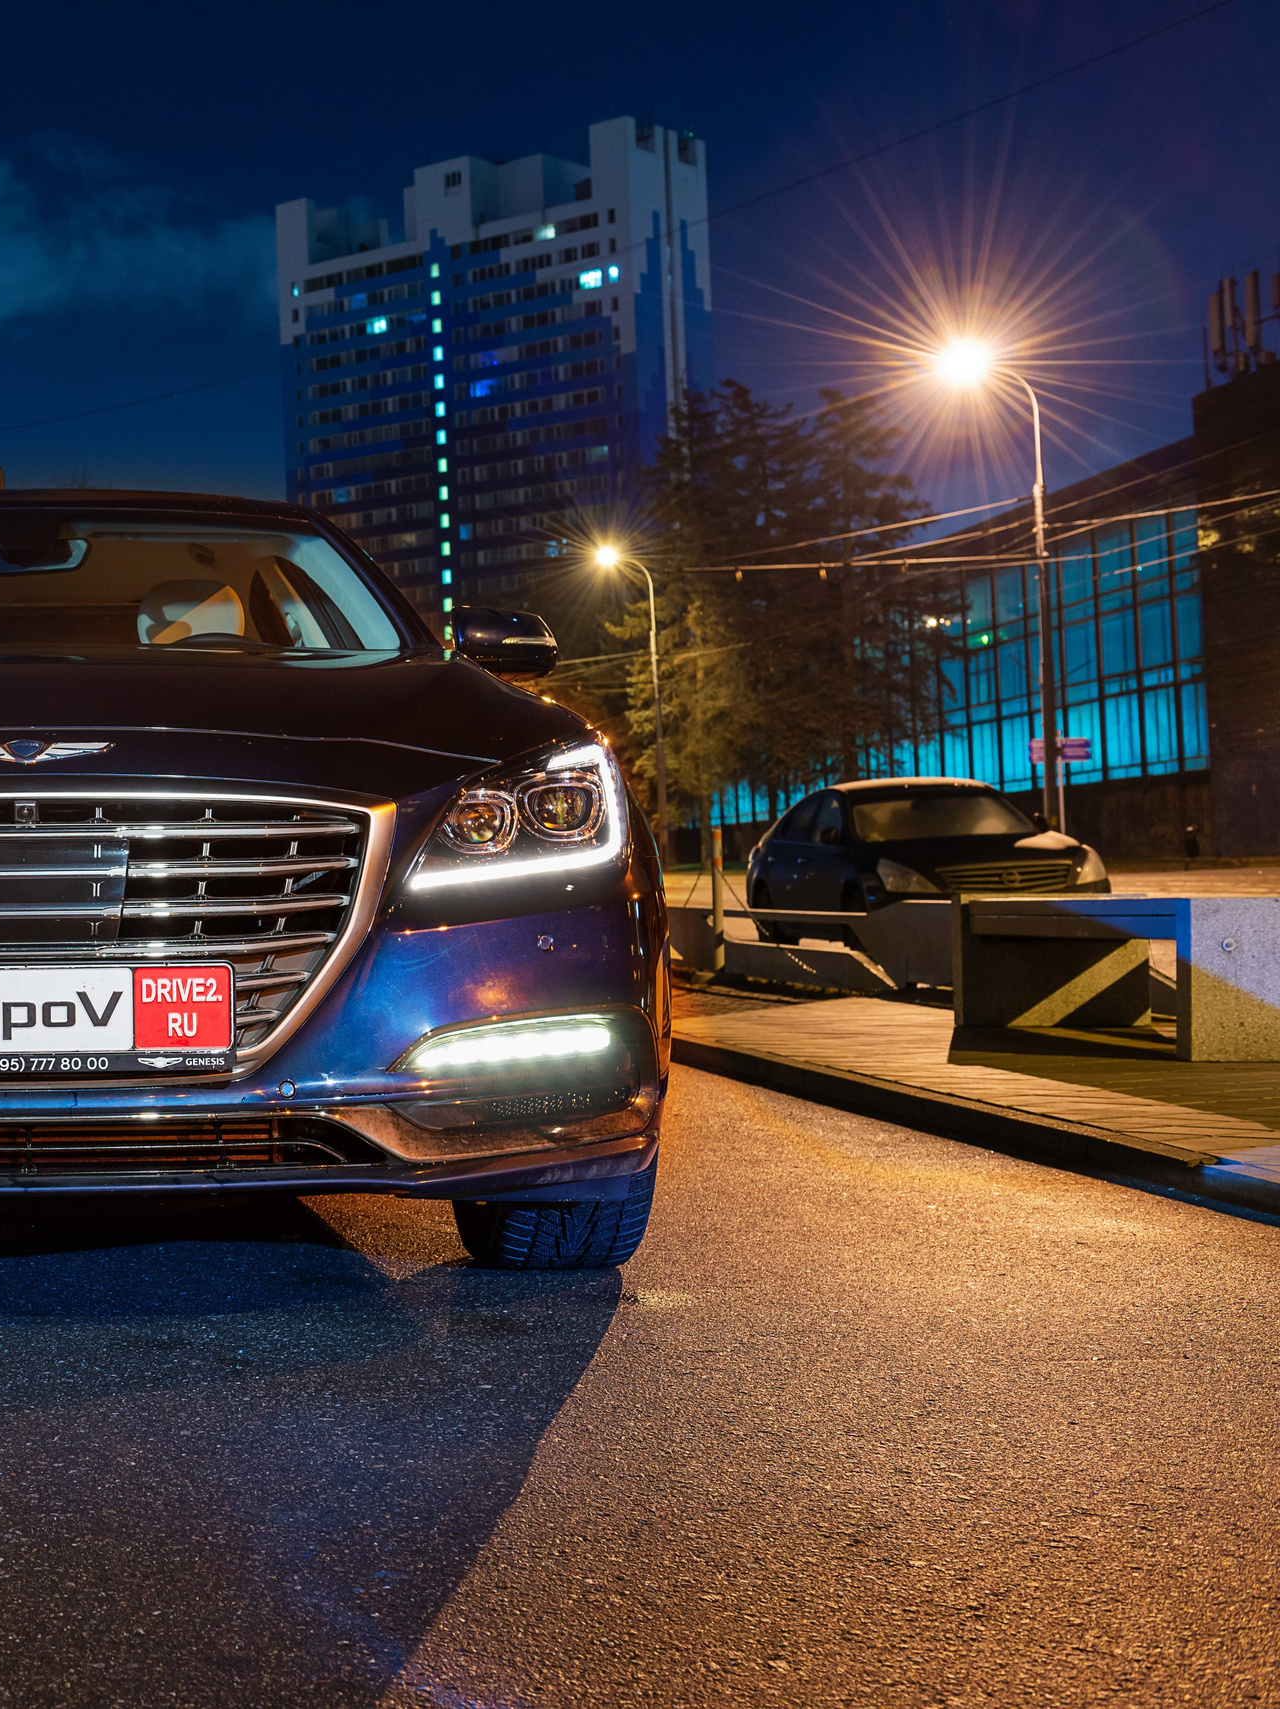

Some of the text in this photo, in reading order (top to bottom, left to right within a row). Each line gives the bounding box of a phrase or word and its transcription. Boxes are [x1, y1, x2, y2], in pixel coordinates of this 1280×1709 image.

[167, 1012, 198, 1037] RU
[29, 1057, 56, 1071] 777
[60, 1057, 82, 1071] 80
[86, 1057, 109, 1071] 00
[185, 1057, 226, 1066] GENESIS
